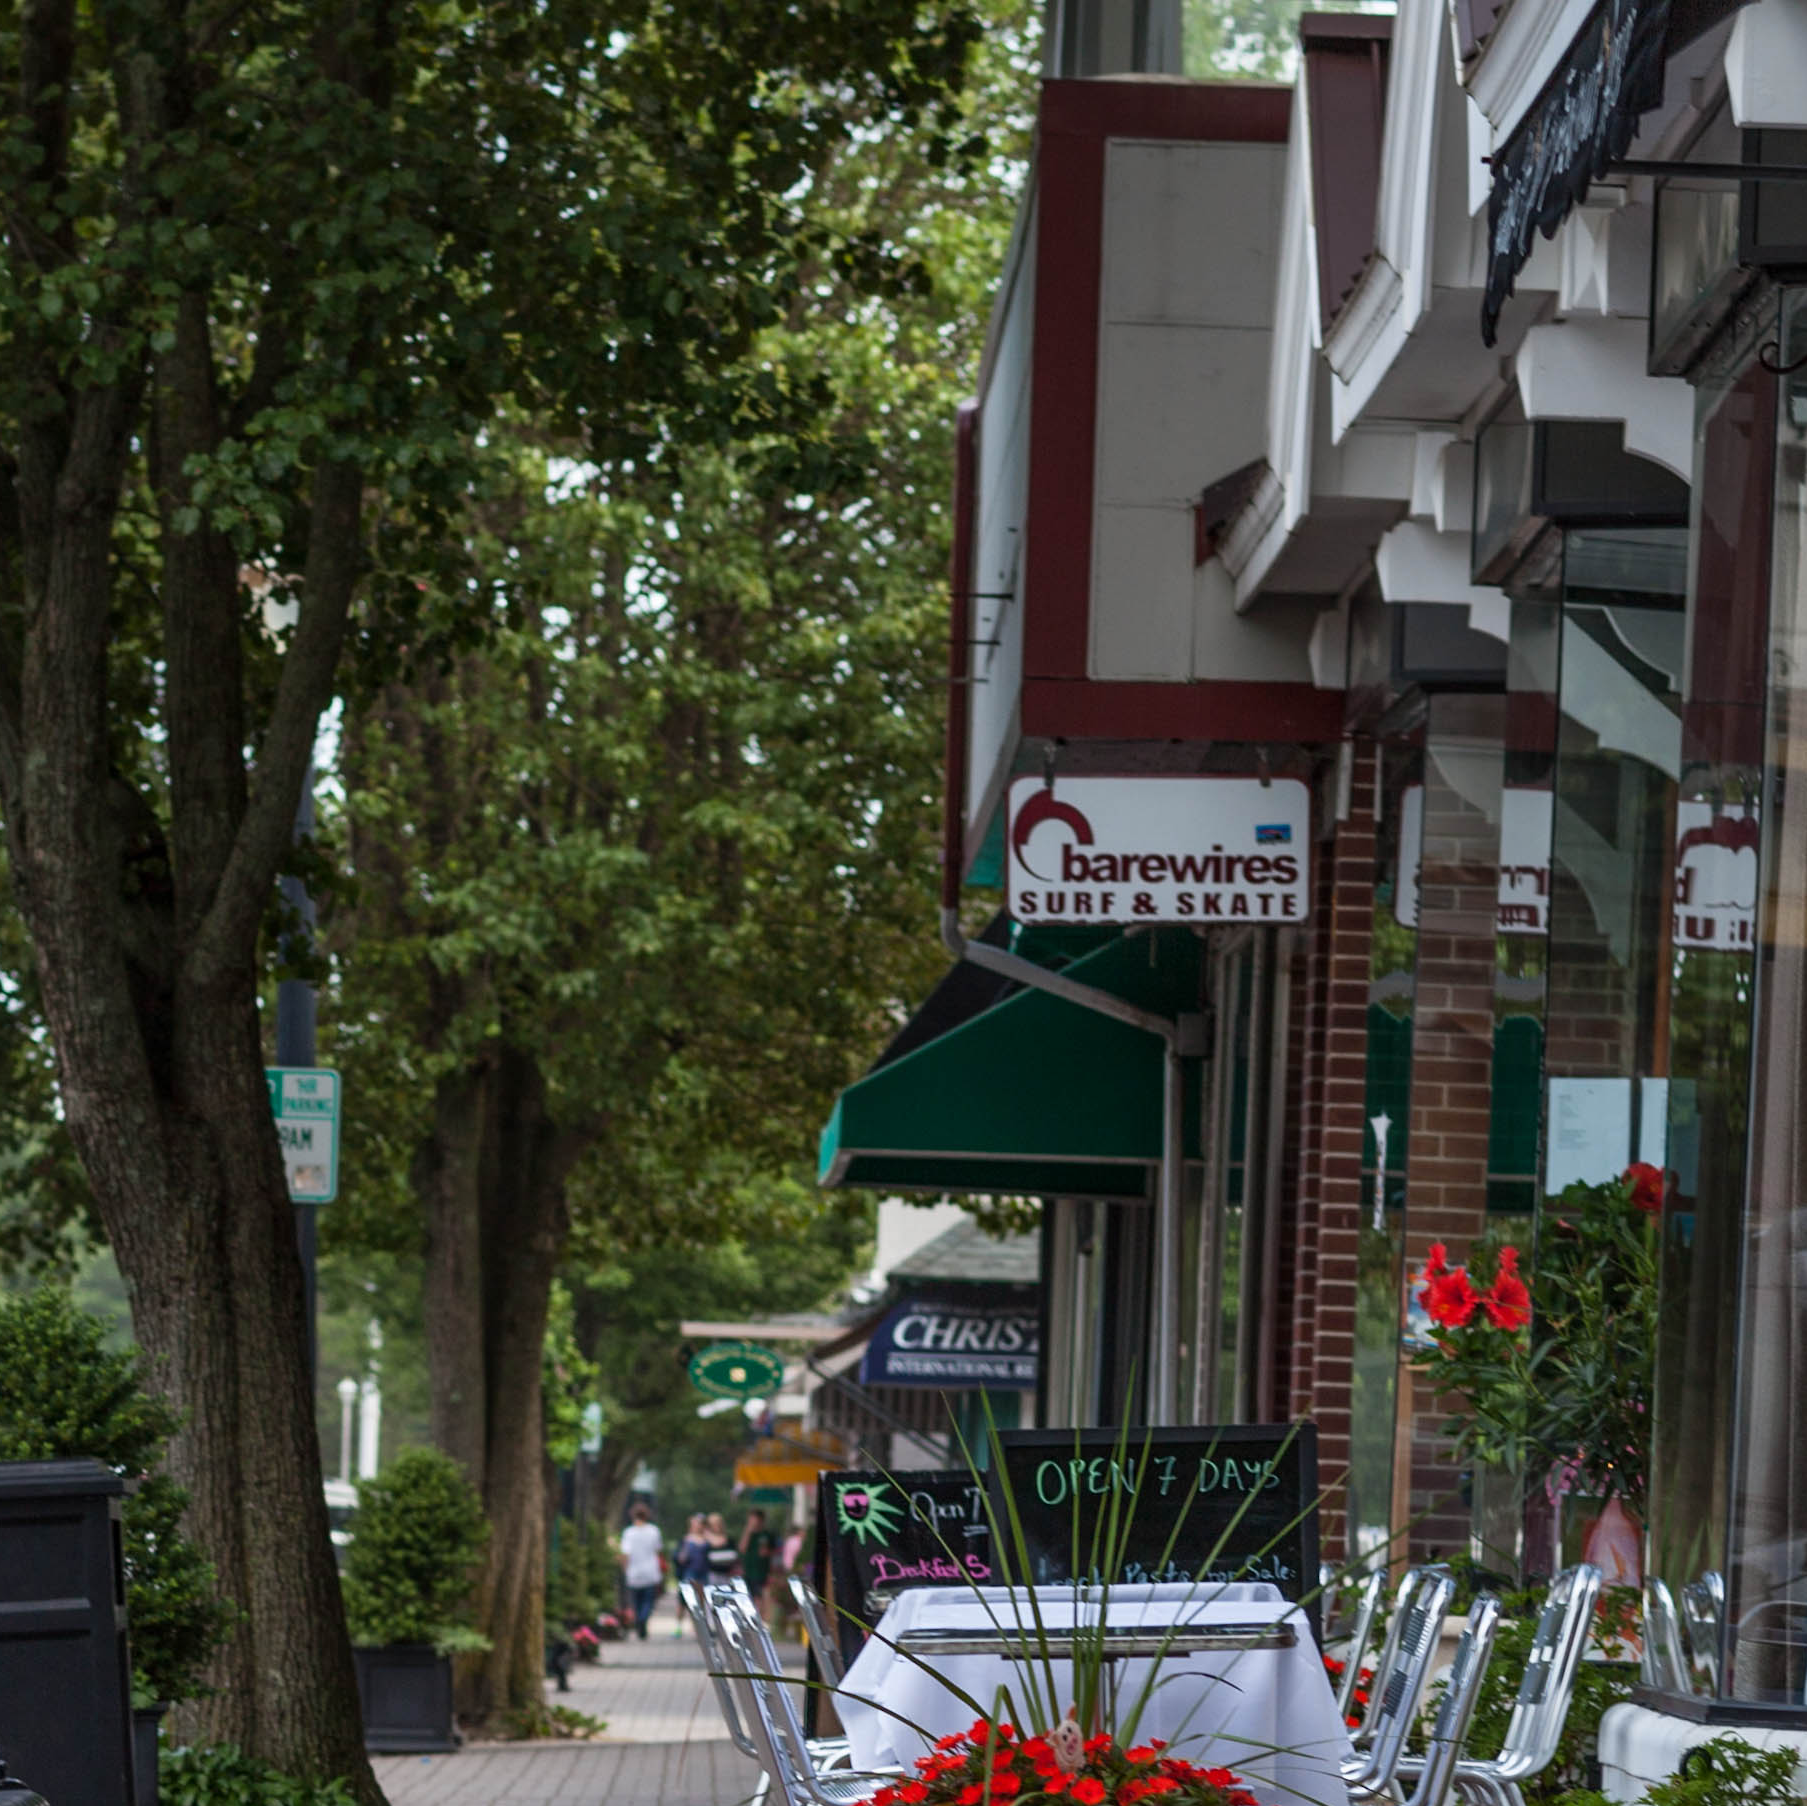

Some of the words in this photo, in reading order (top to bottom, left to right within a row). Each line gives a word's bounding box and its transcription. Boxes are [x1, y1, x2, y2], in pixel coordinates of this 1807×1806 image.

[1061, 843, 1299, 885] barewires
[1019, 891, 1116, 915] SURF
[1132, 891, 1159, 915] &
[1176, 892, 1297, 917] SKATE
[1036, 1457, 1136, 1505] OPEN
[1154, 1456, 1177, 1496] 7
[1198, 1457, 1281, 1494] DAYS
